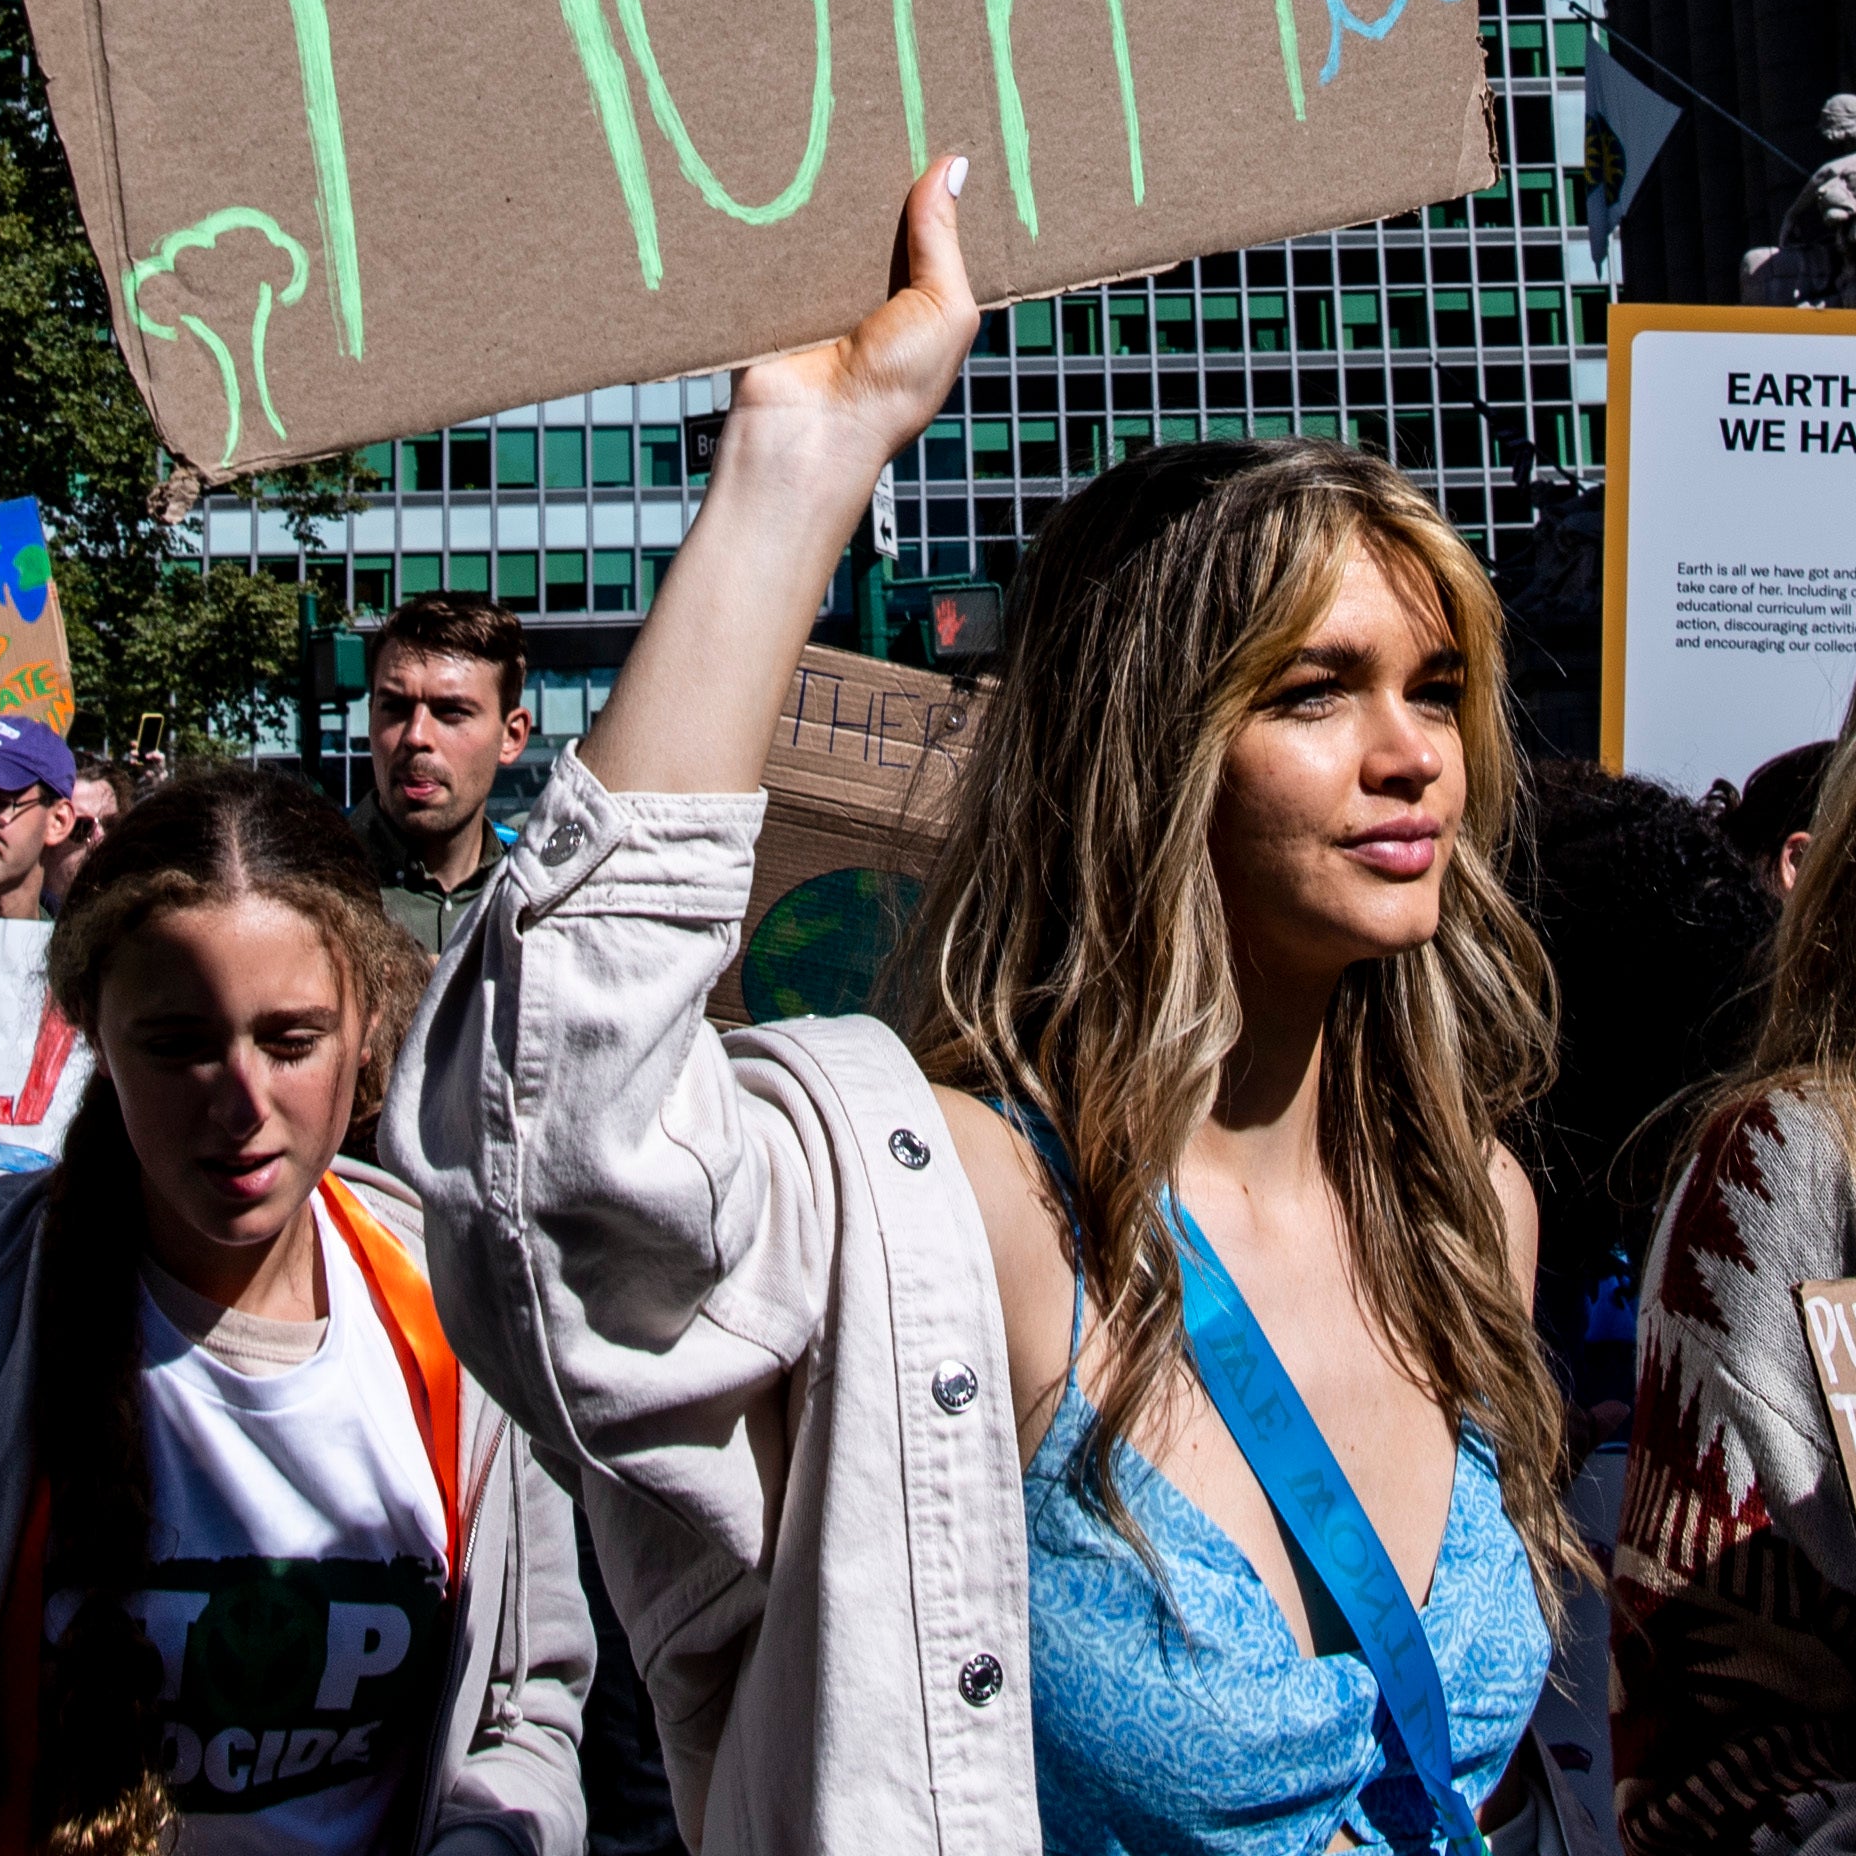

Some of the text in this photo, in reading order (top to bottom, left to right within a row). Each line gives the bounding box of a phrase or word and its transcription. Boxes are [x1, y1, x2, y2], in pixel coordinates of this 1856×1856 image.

[1720, 418, 1785, 451] WE
[1678, 562, 1712, 575] Earth
[1717, 564, 1728, 576] is
[1732, 564, 1746, 576] all
[1751, 567, 1769, 577] we
[1774, 565, 1804, 578] have
[1809, 568, 1829, 581] got
[1677, 581, 1705, 593] take
[1709, 584, 1737, 595] care
[1742, 582, 1754, 595] of
[1759, 583, 1783, 596] her.
[1788, 584, 1847, 600] Including
[1676, 599, 1752, 613] educational
[1757, 603, 1826, 615] curriculum
[1831, 604, 1851, 616] will
[1676, 618, 1720, 631] action,
[1724, 619, 1807, 635] discouraging
[1676, 636, 1700, 648] and
[1704, 638, 1785, 653] encouraging
[1789, 642, 1810, 651] our
[161, 1720, 382, 1794] OCIDE
